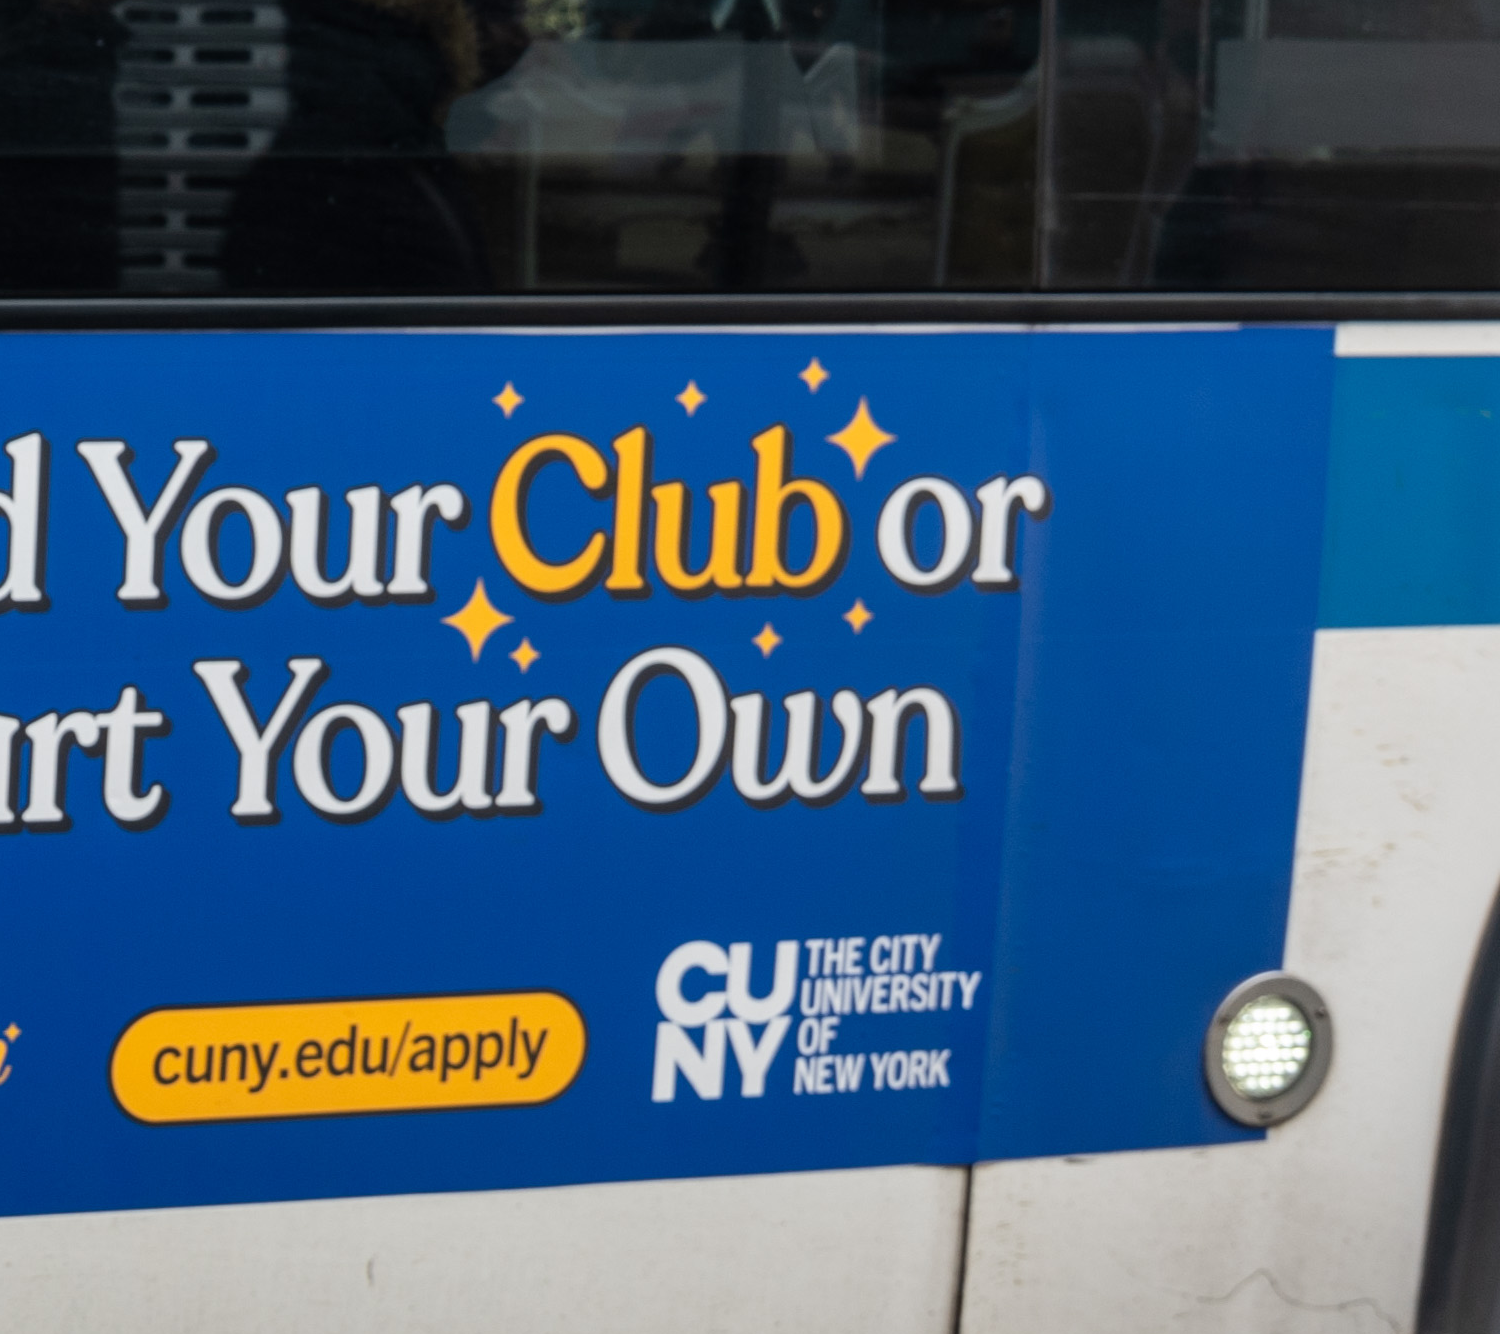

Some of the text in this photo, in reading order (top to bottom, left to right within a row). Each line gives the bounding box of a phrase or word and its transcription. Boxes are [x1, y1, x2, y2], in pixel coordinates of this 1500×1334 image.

[76, 439, 466, 601] Your
[488, 423, 846, 595] Club
[876, 474, 1047, 587] or
[192, 657, 573, 817] Your
[597, 646, 958, 804] Own
[804, 933, 941, 978] THE CITY
[800, 970, 982, 1017] UNIVERSITY
[152, 1016, 549, 1094] cuny.edu/apply
[797, 1016, 841, 1056] OF
[793, 1049, 951, 1095] NEW YORK
